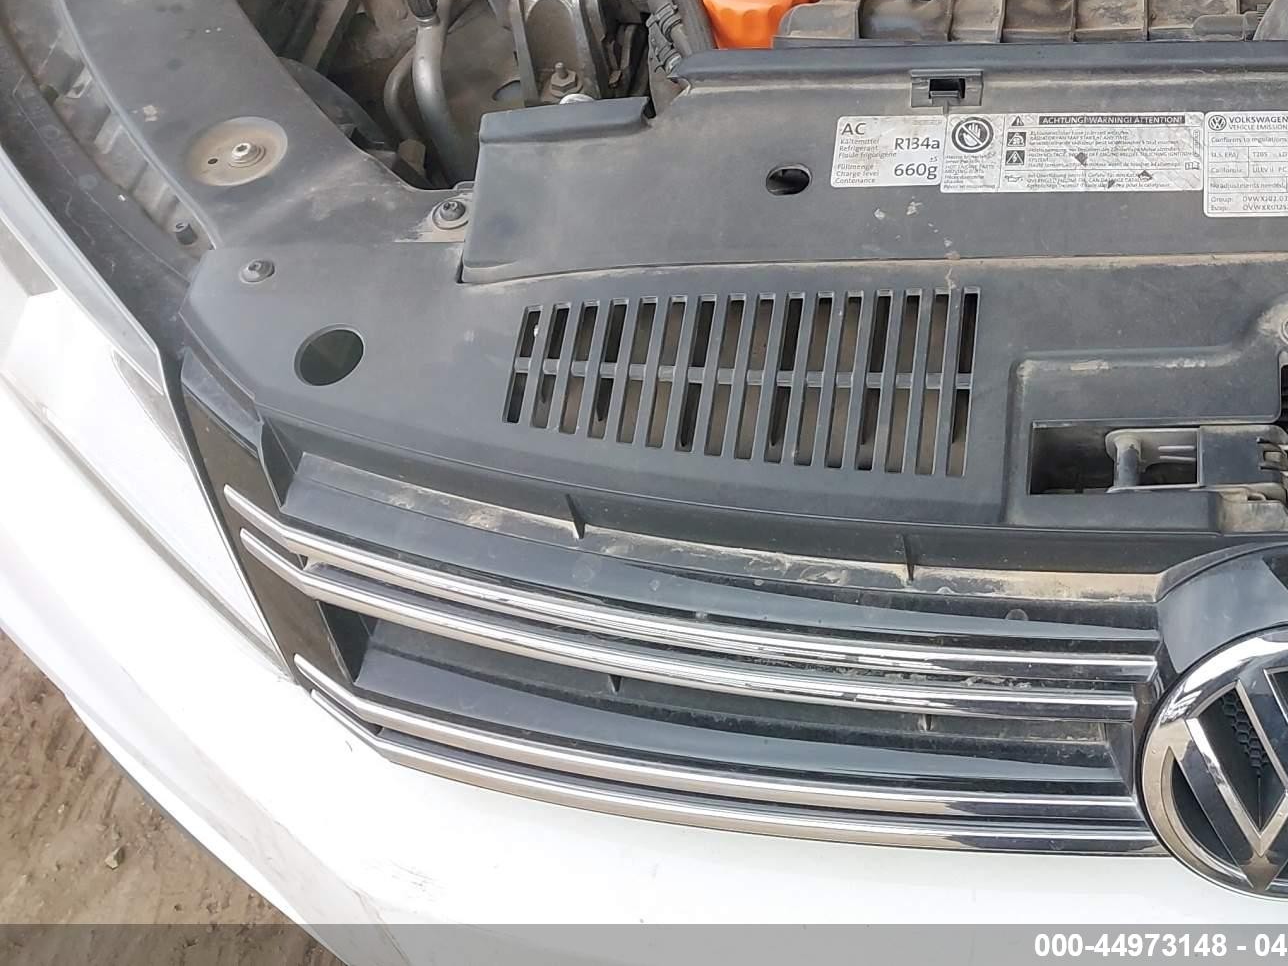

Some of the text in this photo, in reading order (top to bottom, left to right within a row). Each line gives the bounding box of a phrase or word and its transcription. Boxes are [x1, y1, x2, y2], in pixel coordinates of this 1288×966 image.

[1134, 115, 1183, 124] ATTENTION!
[841, 122, 866, 135] AC
[894, 137, 941, 150] R134a
[894, 163, 938, 180] 660g
